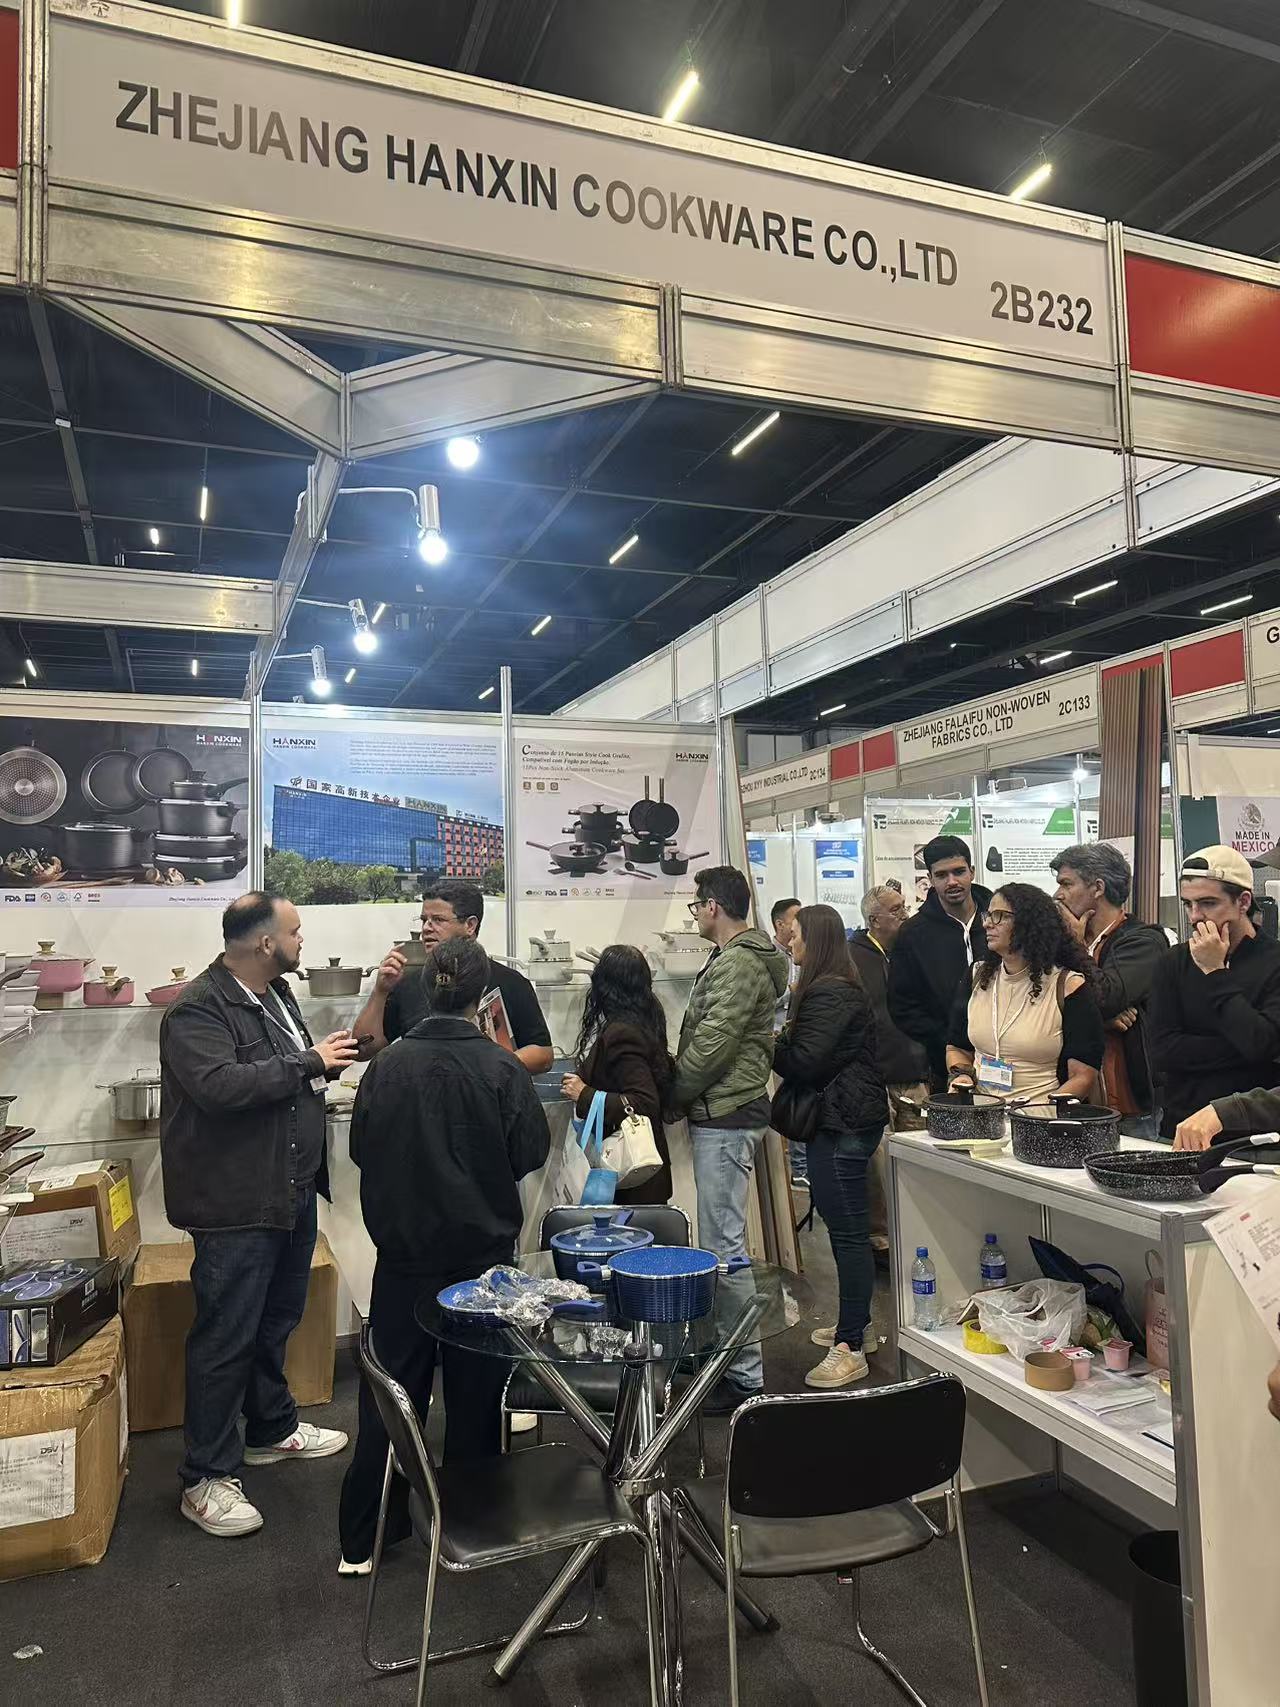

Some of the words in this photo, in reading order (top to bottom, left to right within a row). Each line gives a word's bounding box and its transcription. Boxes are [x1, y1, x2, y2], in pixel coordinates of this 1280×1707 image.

[115, 80, 370, 174] ZHEJIANG
[386, 134, 559, 211] HANXIN
[572, 173, 815, 261] COOKWARE
[823, 224, 959, 287] CO.,LTD
[990, 280, 1094, 336] 2B232
[1058, 694, 1091, 716] 2C133
[903, 721, 944, 743] ZHEJIANG
[944, 709, 984, 733] FALAIFU
[986, 689, 1051, 720] NON-WOVEN
[931, 726, 971, 749] FABRICS
[972, 722, 993, 737] CO.,
[995, 715, 1014, 732] LTD
[273, 737, 316, 746] HANXIN
[676, 752, 709, 760] HANXIN
[1235, 830, 1260, 840] MADE
[1261, 831, 1270, 840] IN
[1231, 840, 1275, 853] MEXICO
[4, 895, 22, 903] FDA
[40, 1445, 60, 1455] DSV
